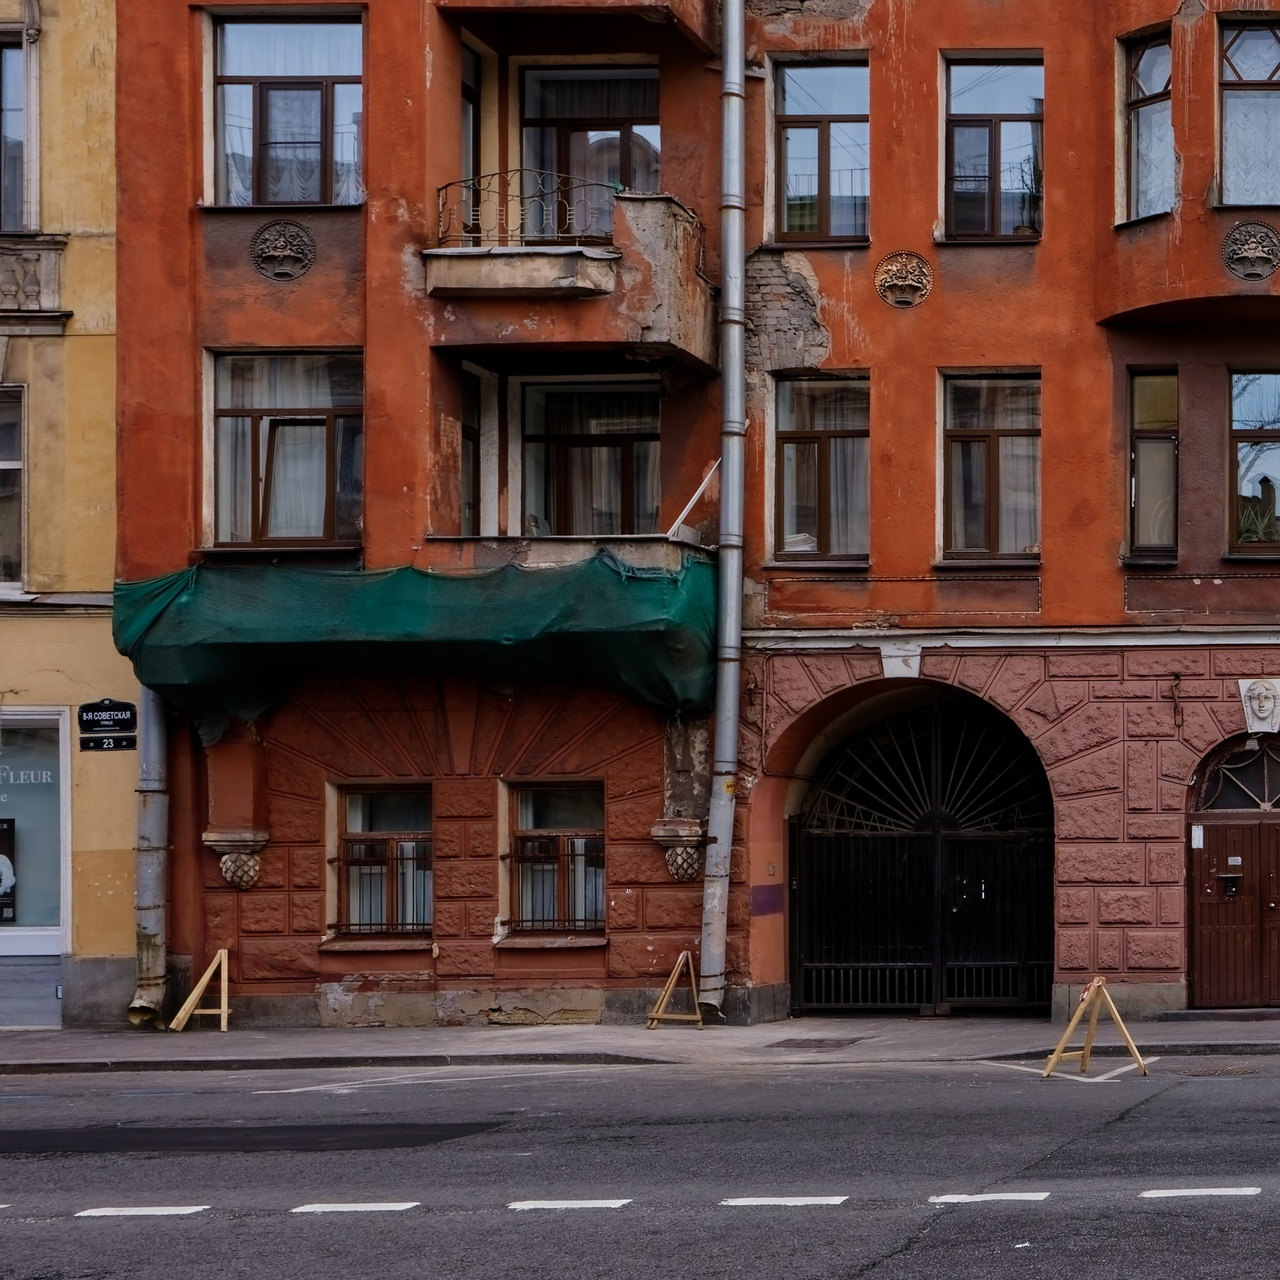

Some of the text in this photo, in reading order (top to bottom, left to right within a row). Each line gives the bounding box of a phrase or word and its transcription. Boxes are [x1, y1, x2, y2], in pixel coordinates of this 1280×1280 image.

[82, 711, 131, 720] 8-Я СОВЕТСКАЯ
[102, 739, 114, 748] 23
[0, 765, 54, 784] FLEUR
